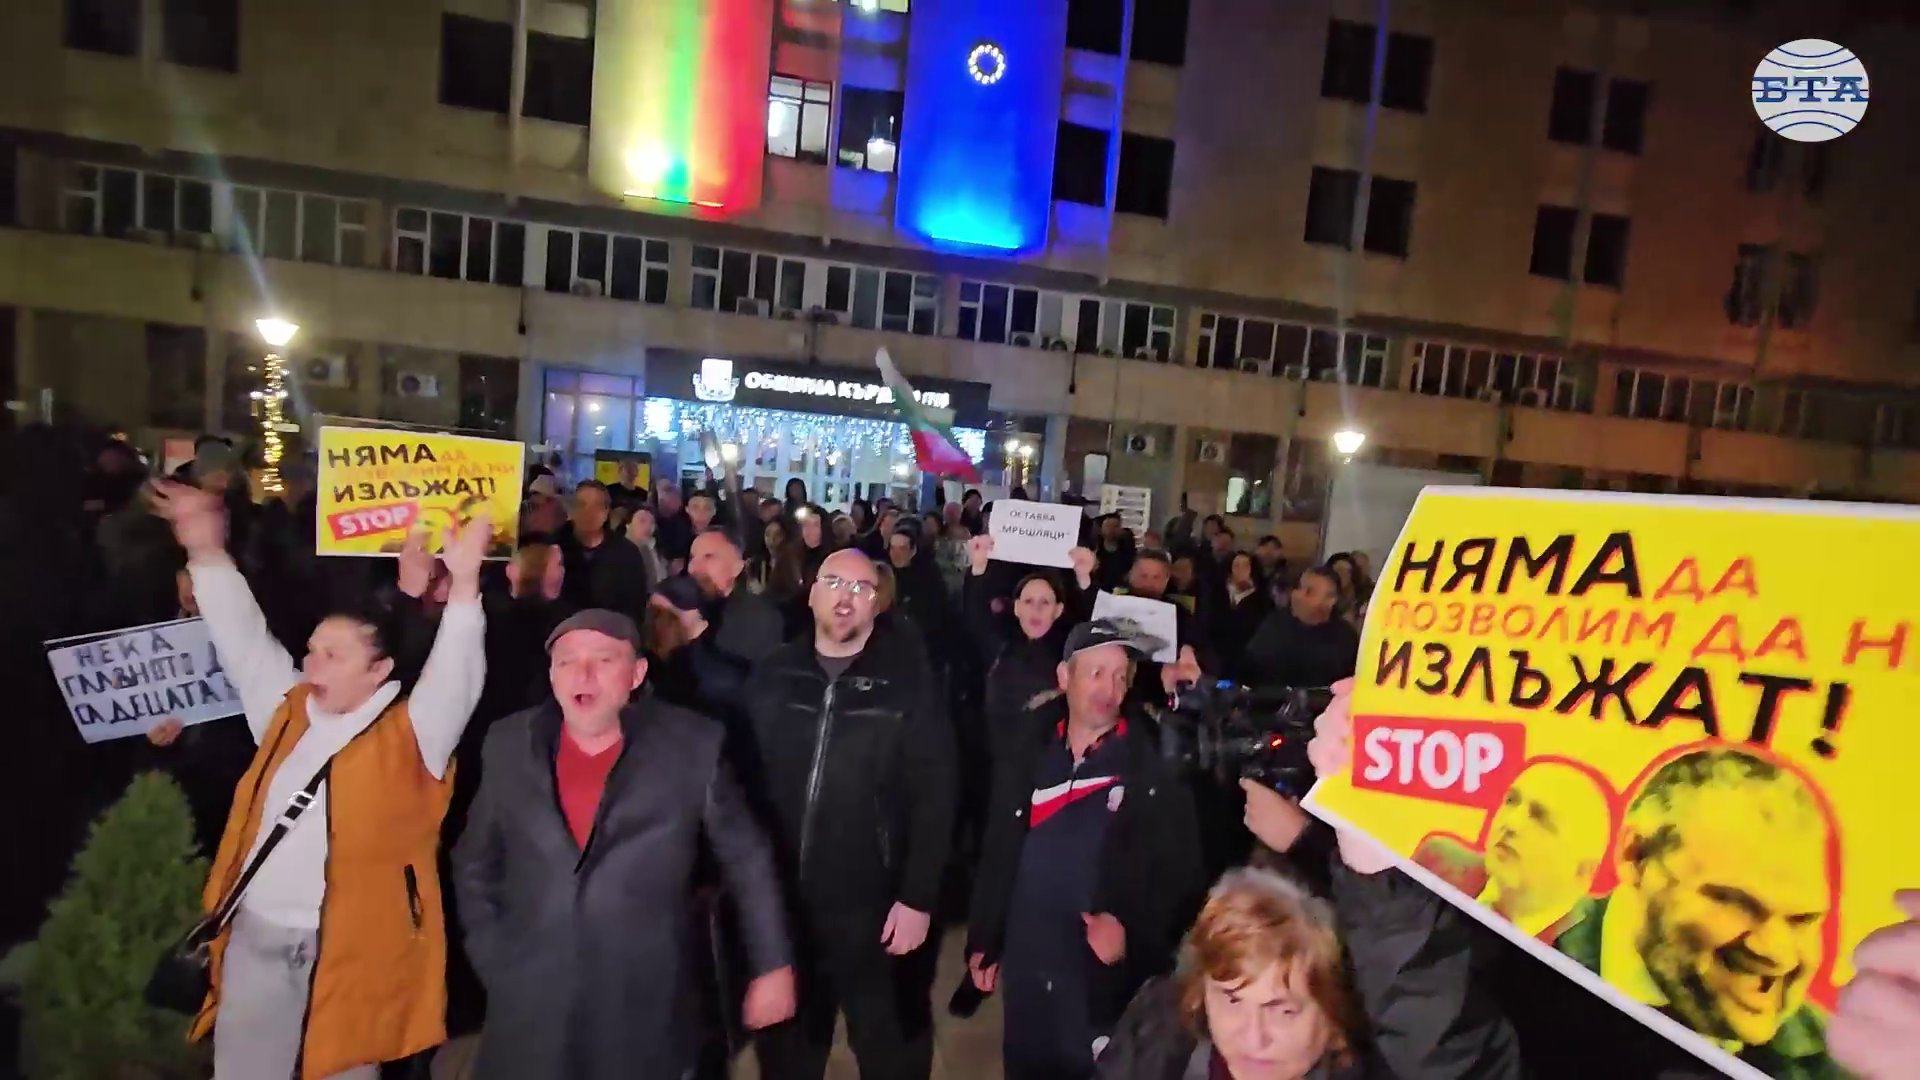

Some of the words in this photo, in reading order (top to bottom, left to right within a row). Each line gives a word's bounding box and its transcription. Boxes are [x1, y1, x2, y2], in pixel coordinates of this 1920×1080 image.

[744, 371, 836, 397] ОБЩИНА
[328, 444, 437, 469] НЯМА
[441, 449, 467, 463] ДА
[338, 506, 410, 536] STOP
[1010, 509, 1056, 522] ОСТАВКА
[1393, 531, 1642, 600] НЯМА
[1653, 554, 1759, 604] ДА
[75, 630, 174, 668] НЕКА
[1383, 598, 1676, 649] ПОЗВОЛИМ
[1691, 613, 1809, 664] ДА
[110, 680, 222, 725] ДЕЦАТА
[1375, 640, 1853, 760] ИЗЛЪЖАТ!
[1364, 724, 1504, 793] STOP
